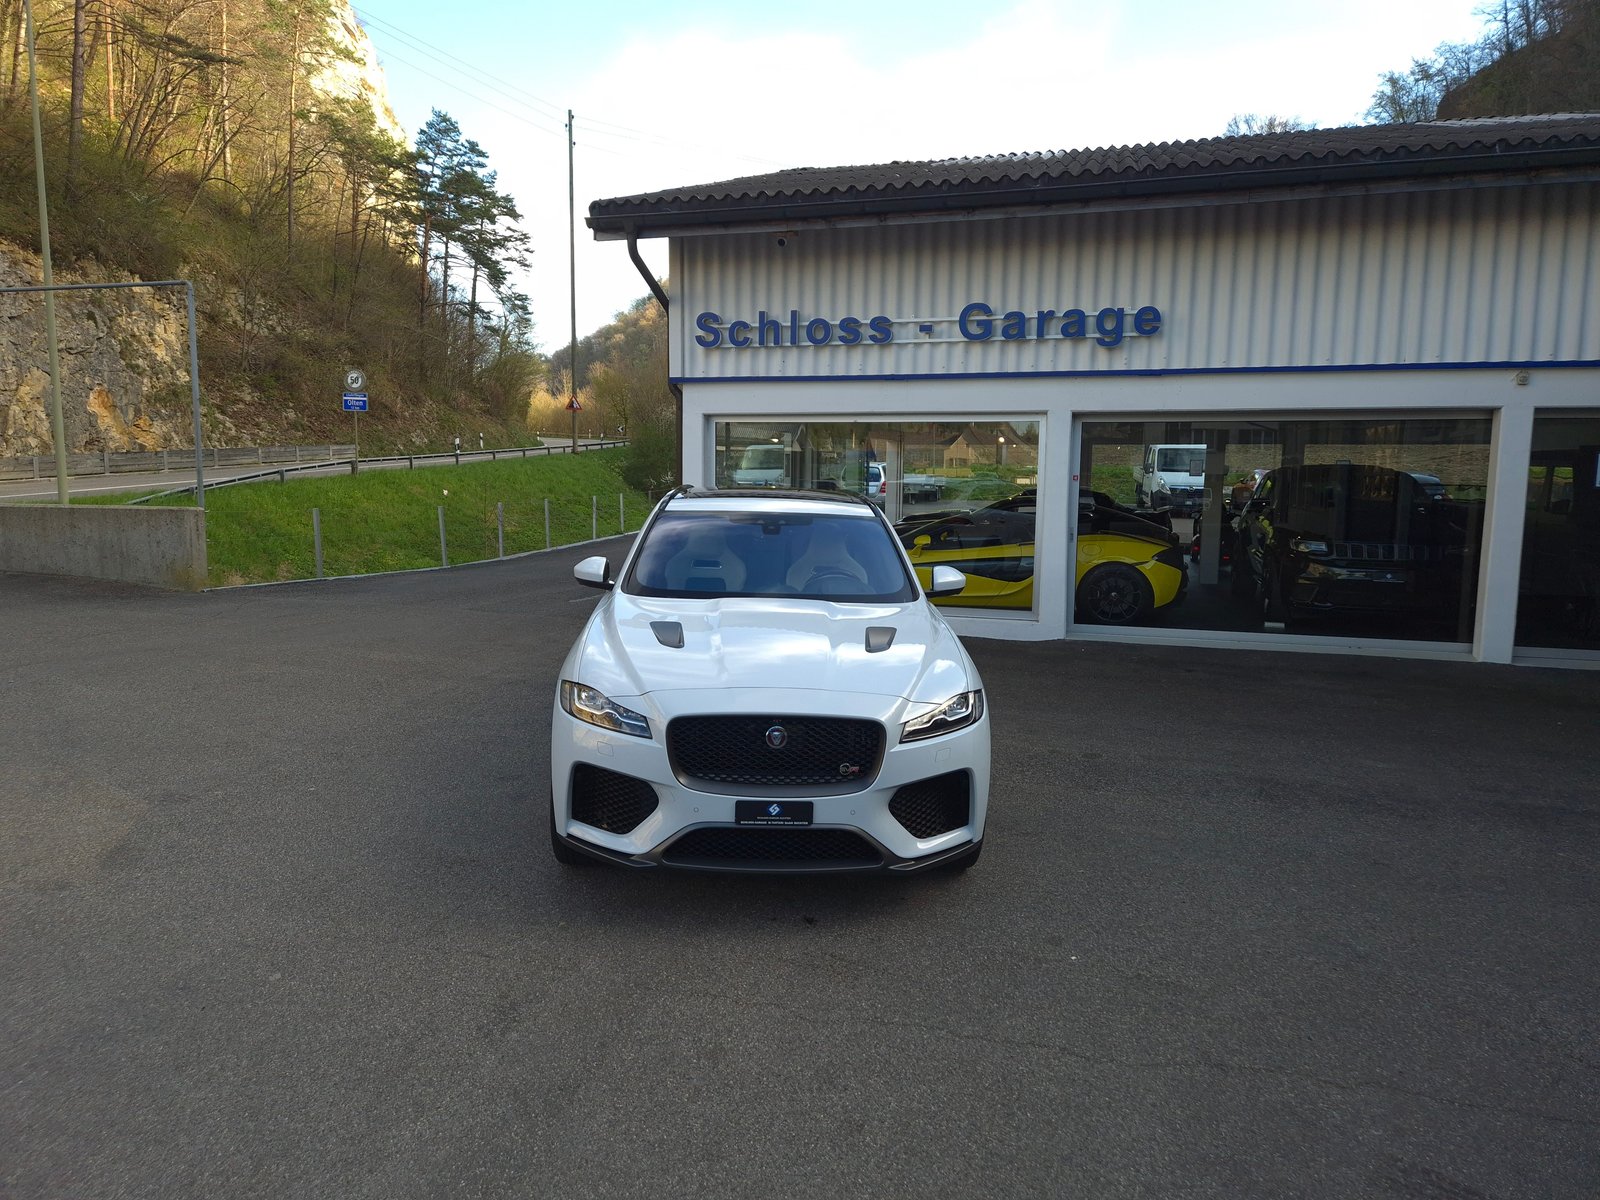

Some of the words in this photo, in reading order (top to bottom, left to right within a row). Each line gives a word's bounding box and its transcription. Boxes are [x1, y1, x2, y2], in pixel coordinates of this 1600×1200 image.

[694, 309, 894, 349] Schloss
[957, 301, 1164, 348] Garage
[350, 376, 359, 385] 50
